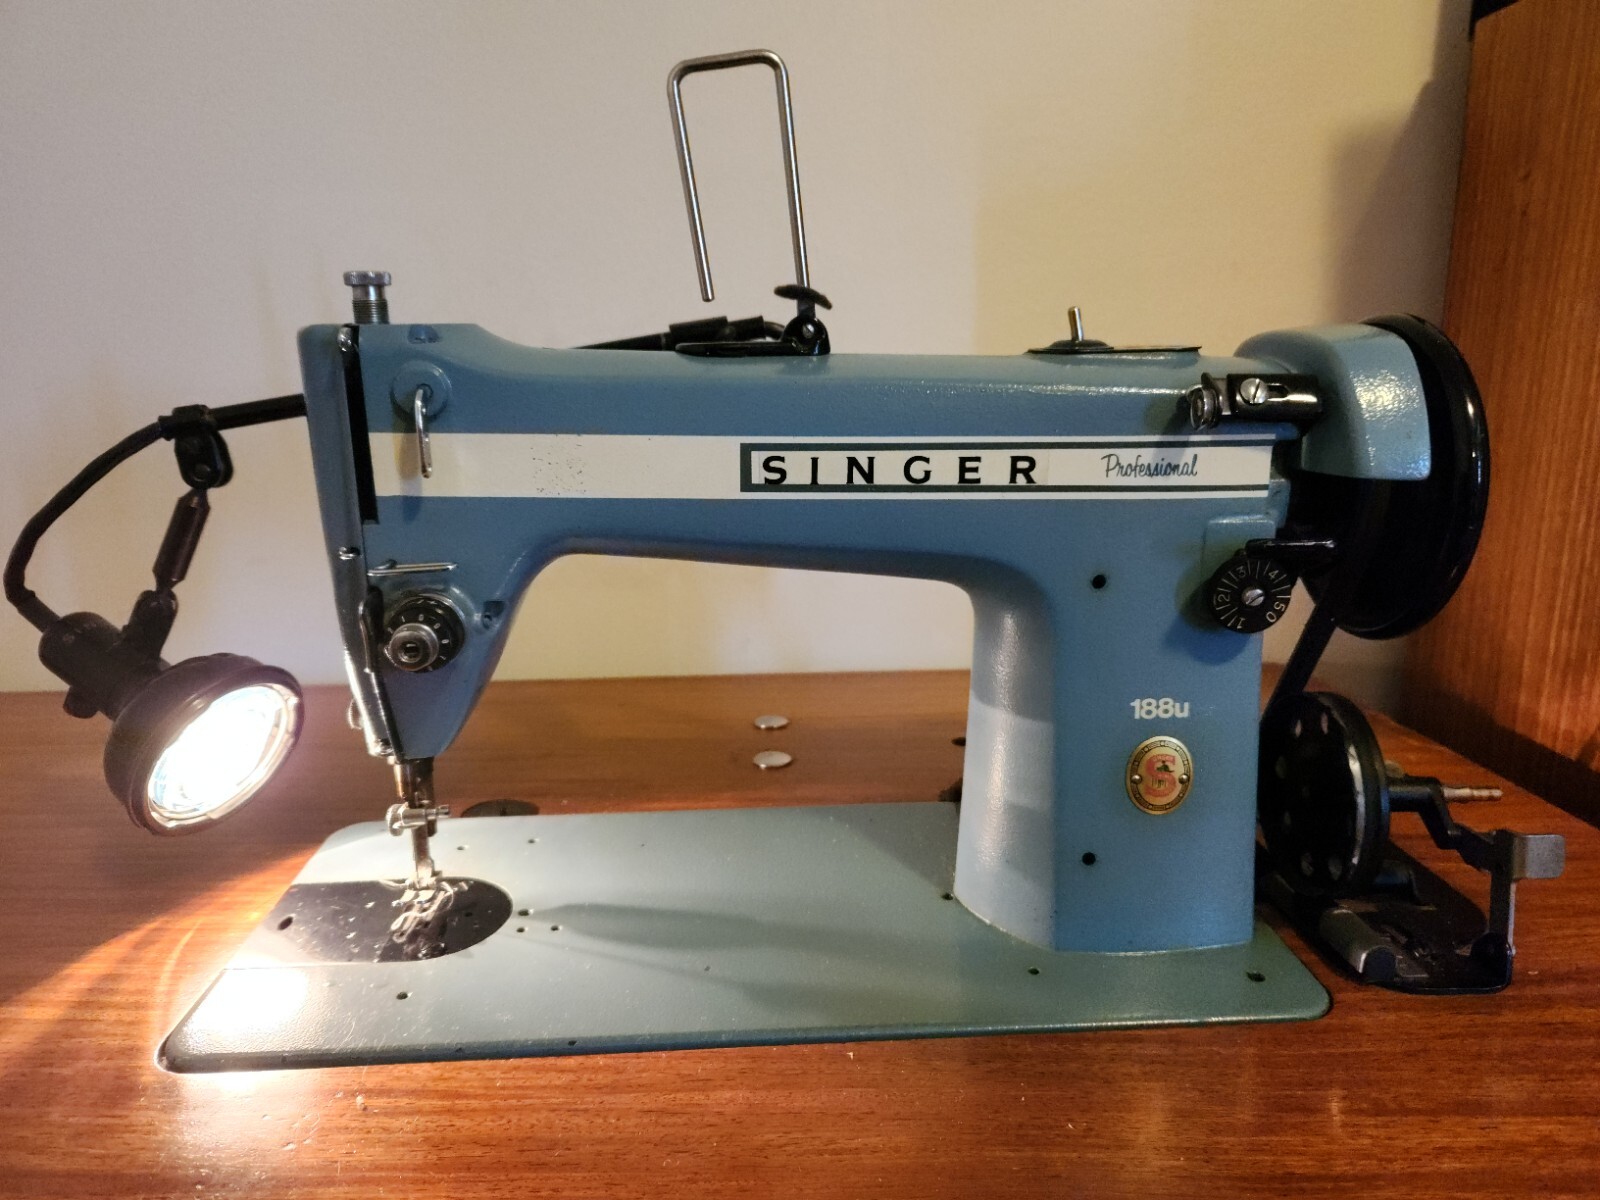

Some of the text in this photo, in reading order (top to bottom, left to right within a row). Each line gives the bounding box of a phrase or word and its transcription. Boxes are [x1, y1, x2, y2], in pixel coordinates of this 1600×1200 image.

[762, 453, 1198, 485] SINGER Professional
[1130, 697, 1190, 720] 188u
